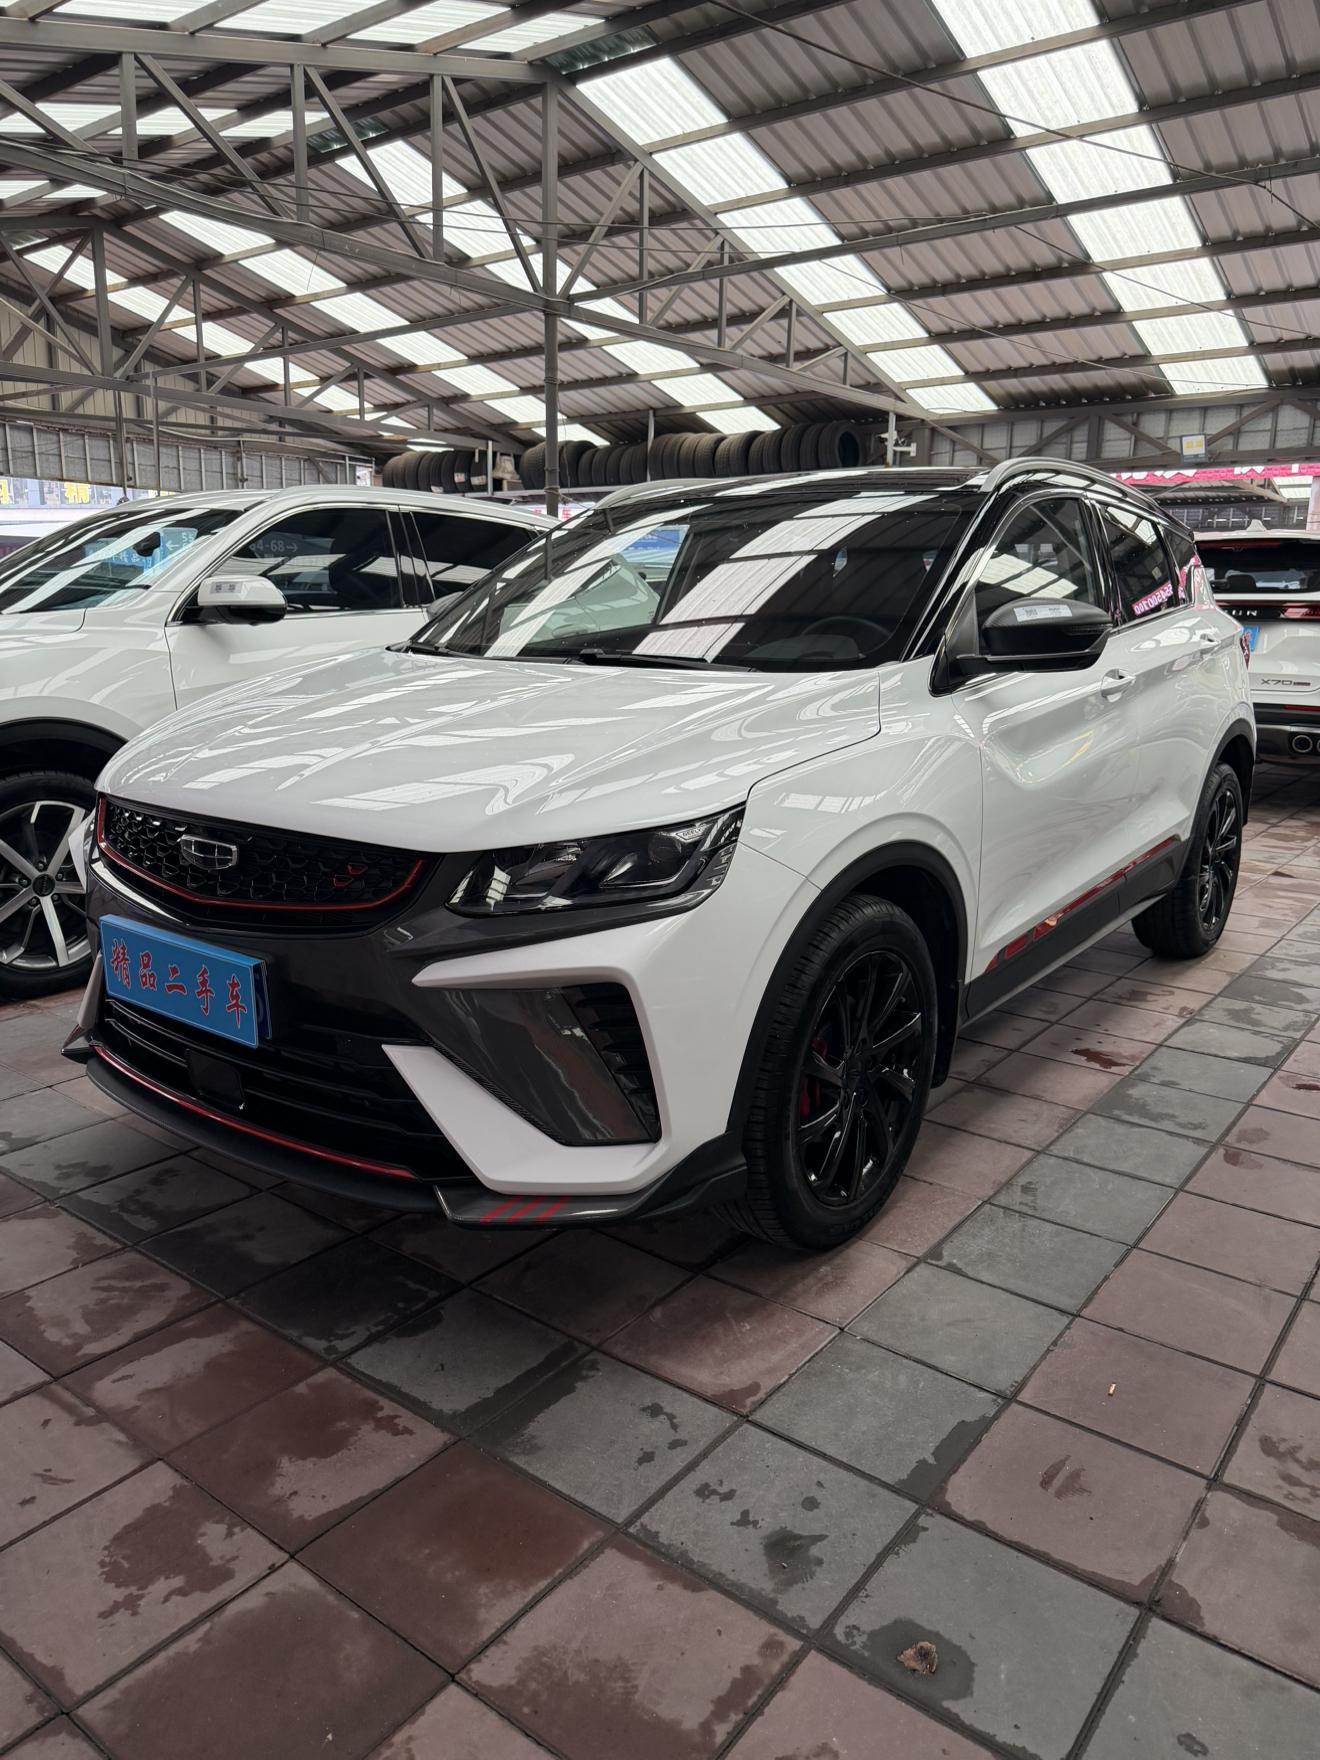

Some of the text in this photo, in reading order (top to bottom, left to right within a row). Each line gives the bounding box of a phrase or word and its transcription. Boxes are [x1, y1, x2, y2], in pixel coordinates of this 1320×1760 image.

[1261, 678, 1293, 686] X70
[110, 937, 248, 1029] 精品二手车
